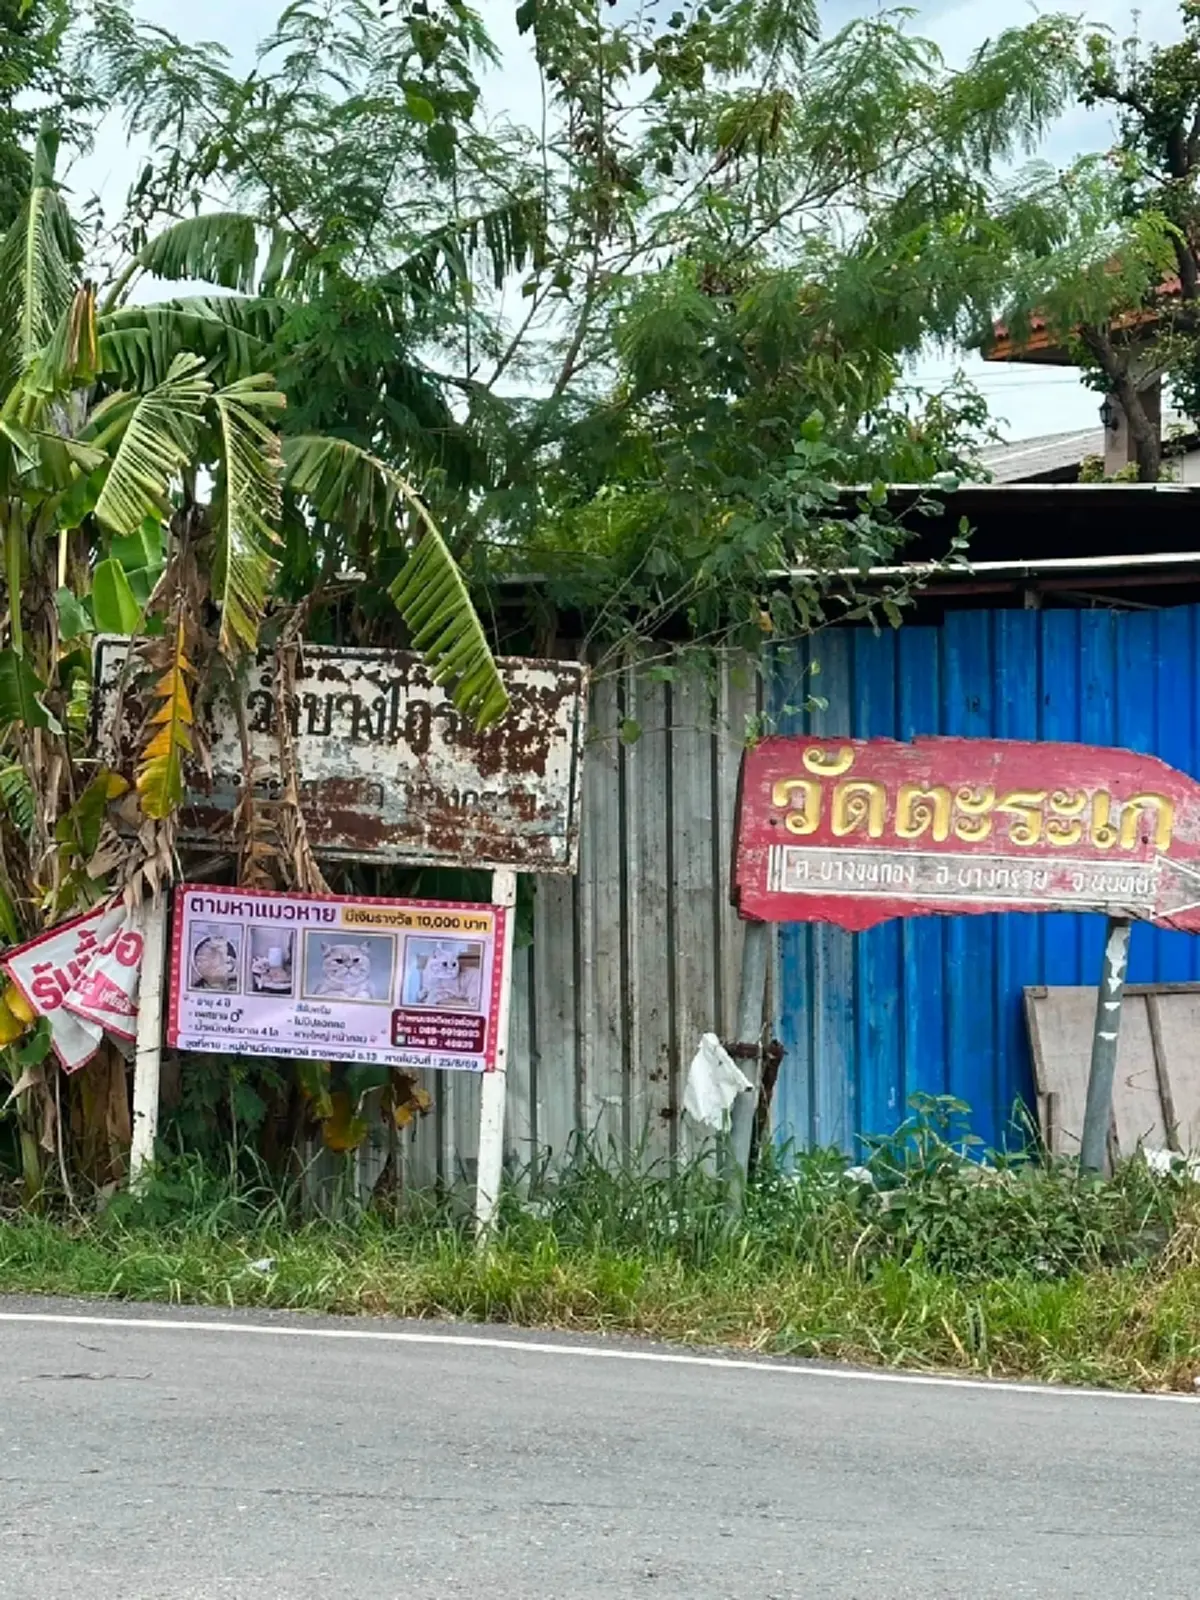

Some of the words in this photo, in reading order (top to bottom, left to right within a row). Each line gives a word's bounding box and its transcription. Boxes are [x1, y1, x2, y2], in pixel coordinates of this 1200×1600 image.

[772, 746, 1177, 852] วัดตะระเก
[190, 898, 336, 922] ตามหาแมวหาย
[416, 915, 460, 929] 10,000
[464, 919, 487, 931] บาท
